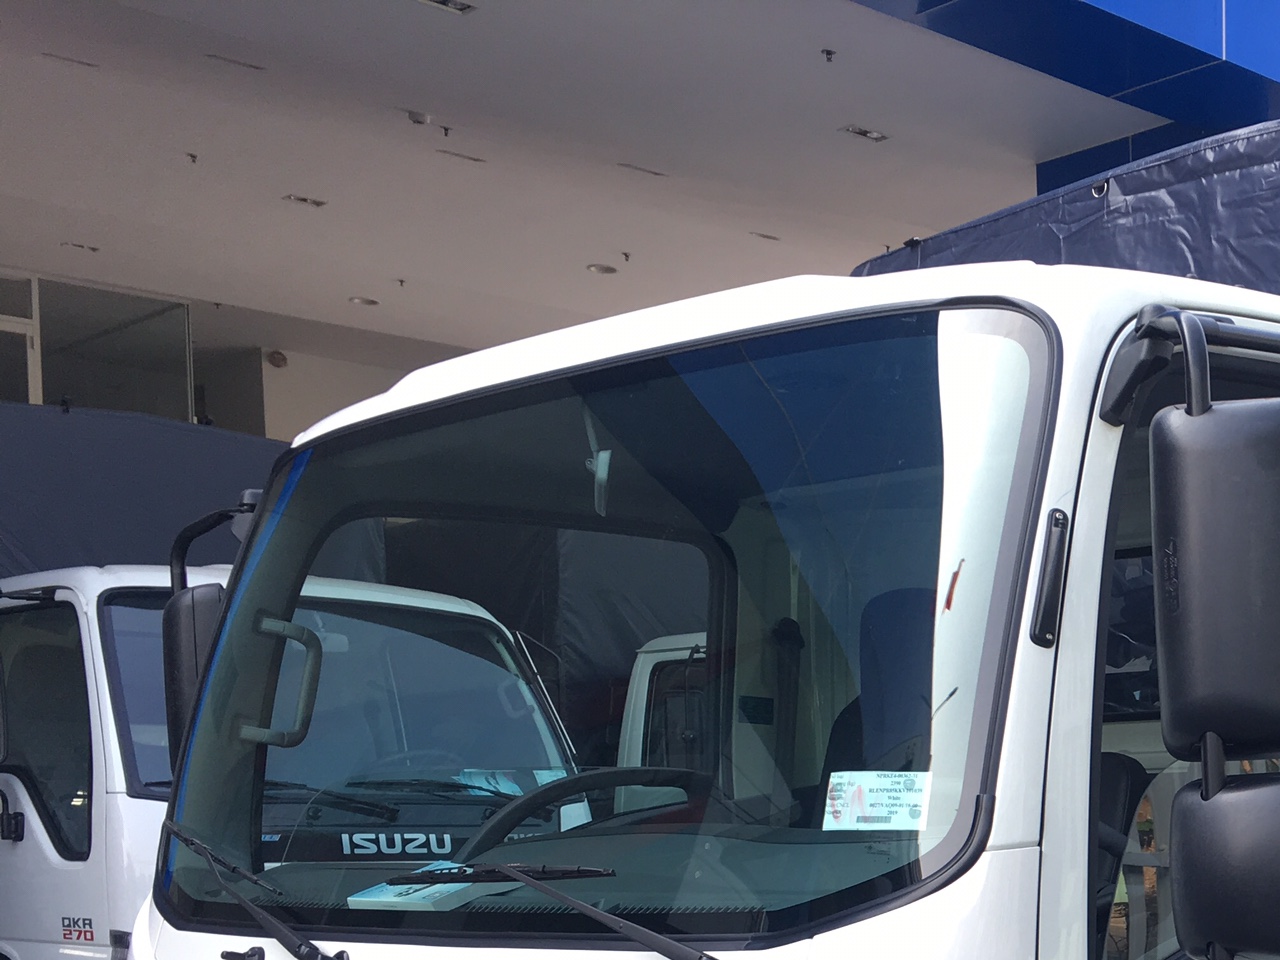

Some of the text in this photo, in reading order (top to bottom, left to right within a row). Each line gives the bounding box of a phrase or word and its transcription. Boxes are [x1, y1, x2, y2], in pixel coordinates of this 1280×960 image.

[341, 834, 452, 855] ISUZU
[61, 916, 93, 930] QKR
[62, 929, 95, 942] 270
